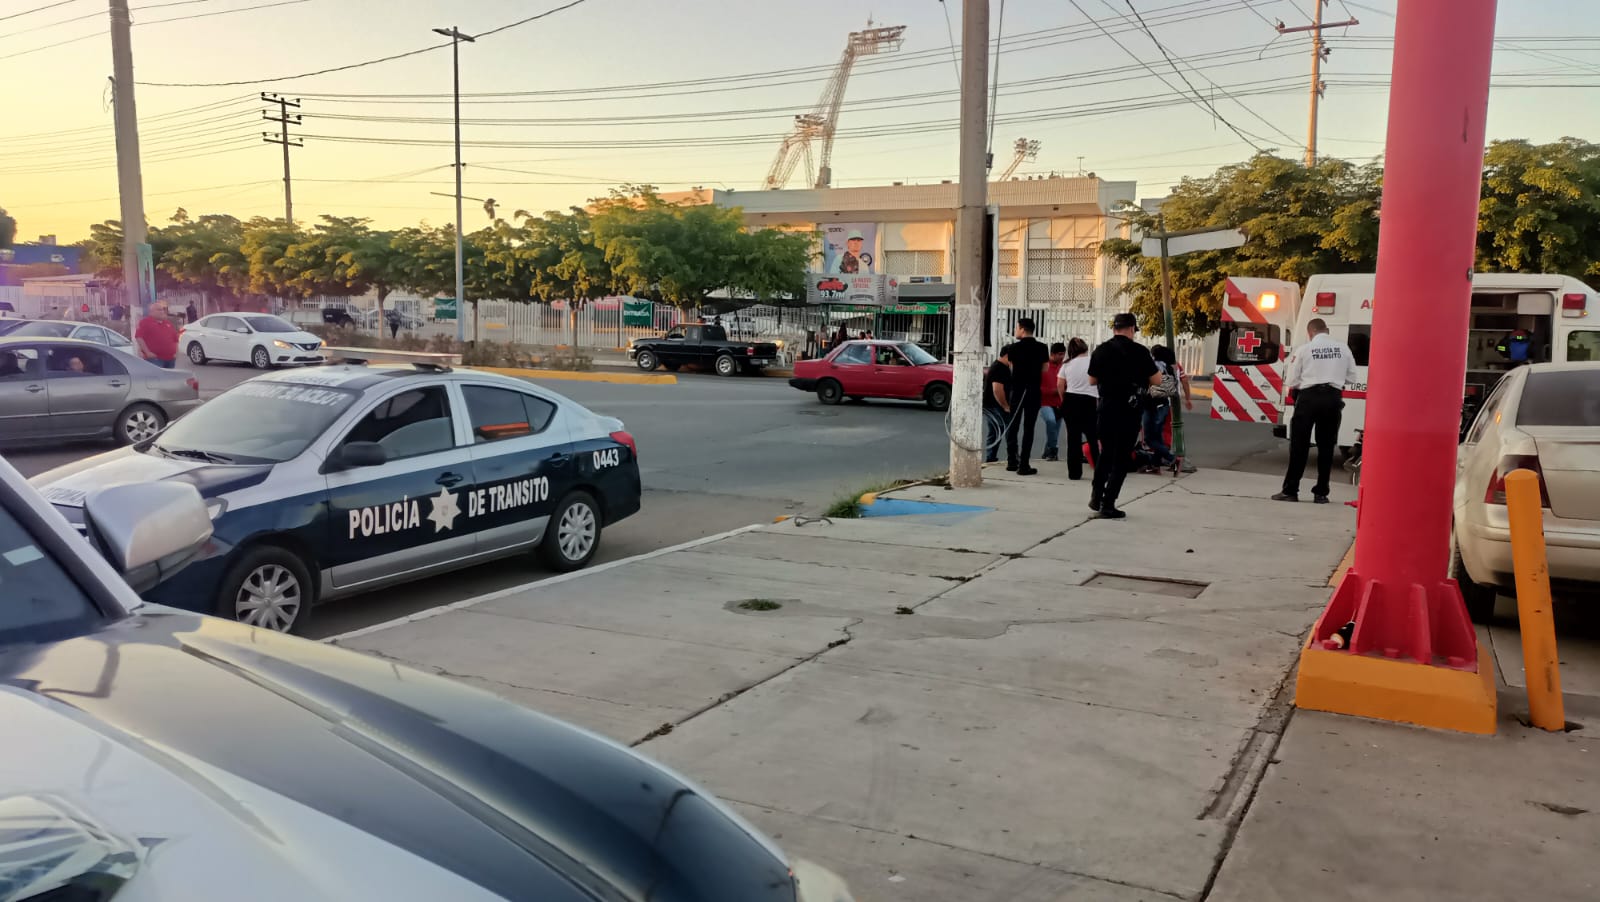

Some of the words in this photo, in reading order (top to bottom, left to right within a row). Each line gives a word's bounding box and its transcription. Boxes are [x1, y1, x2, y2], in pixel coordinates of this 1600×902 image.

[592, 448, 619, 470] 0443
[348, 494, 420, 540] POLICÍA
[468, 488, 486, 518] DE
[488, 475, 549, 513] TRANSITO
